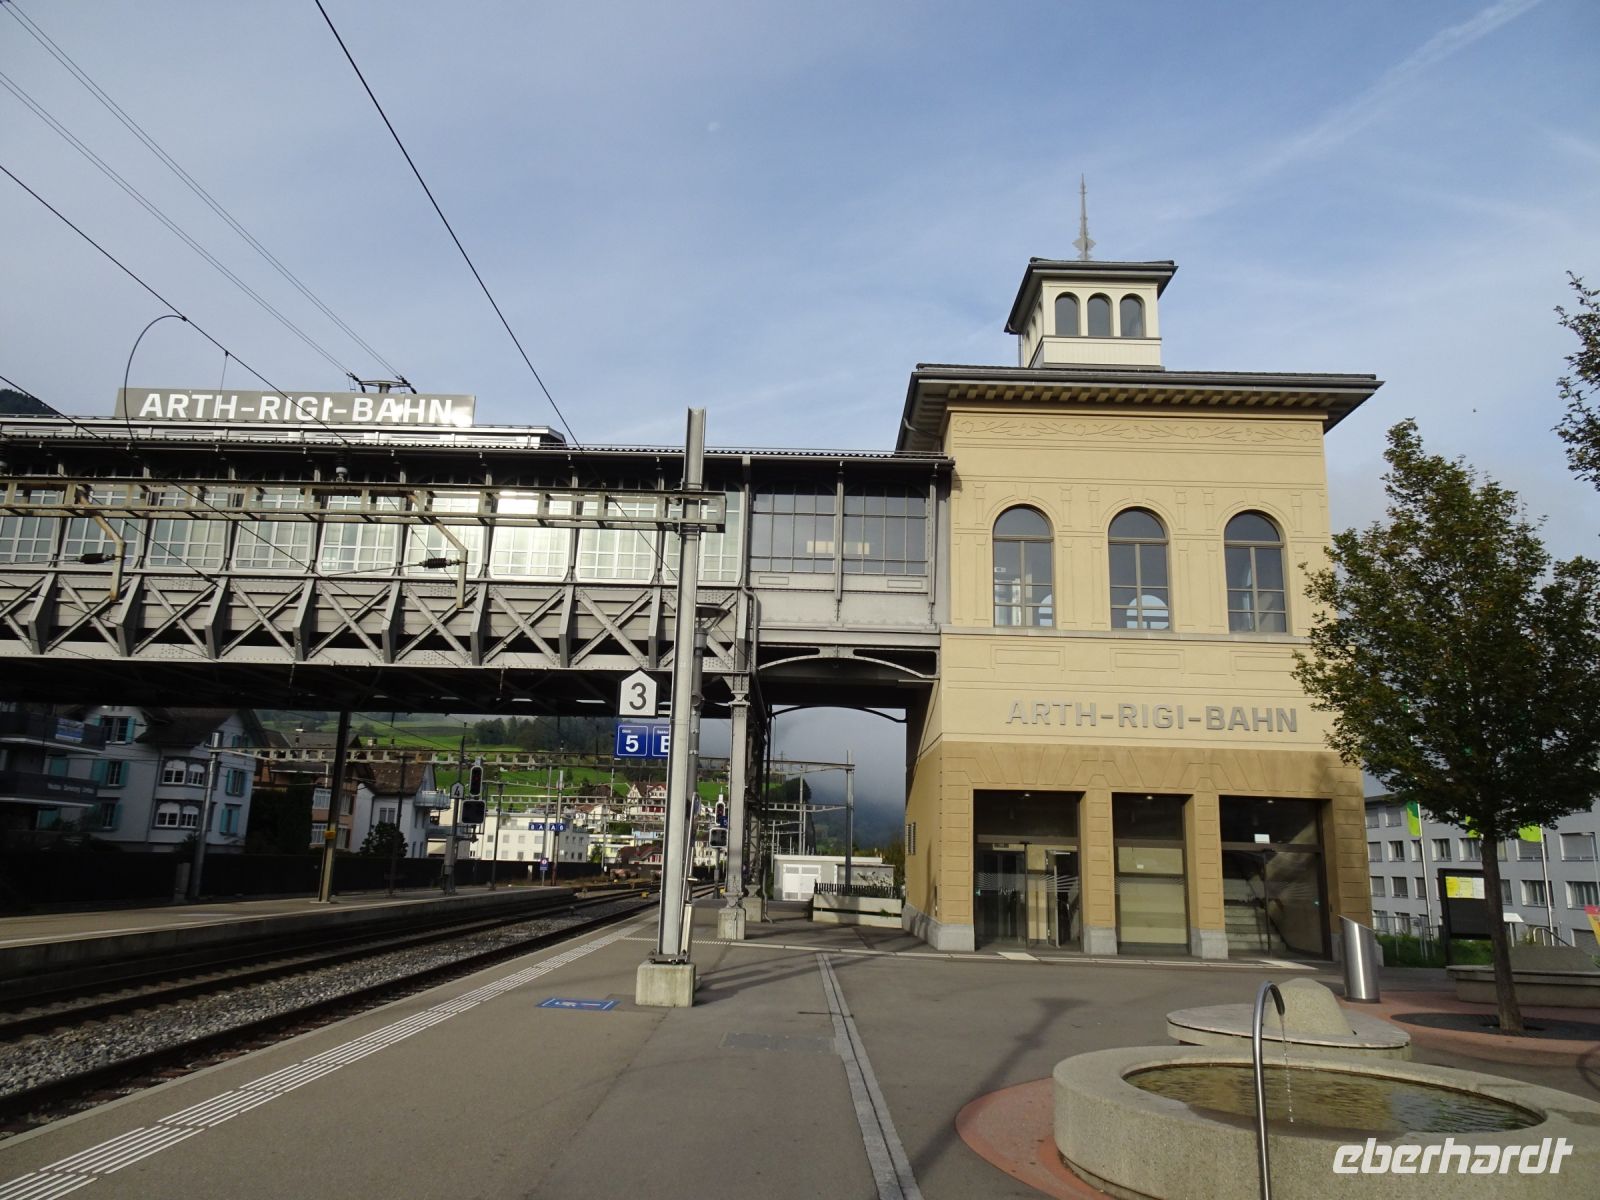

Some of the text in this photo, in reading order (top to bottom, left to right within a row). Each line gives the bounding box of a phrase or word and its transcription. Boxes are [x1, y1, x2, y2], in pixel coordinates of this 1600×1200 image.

[139, 393, 453, 424] ARTH-RIGI-BAHN
[629, 682, 647, 710] 3
[1005, 699, 1298, 733] ARTH-RIGI-BAHN
[625, 734, 639, 753] 5
[454, 785, 460, 797] 4
